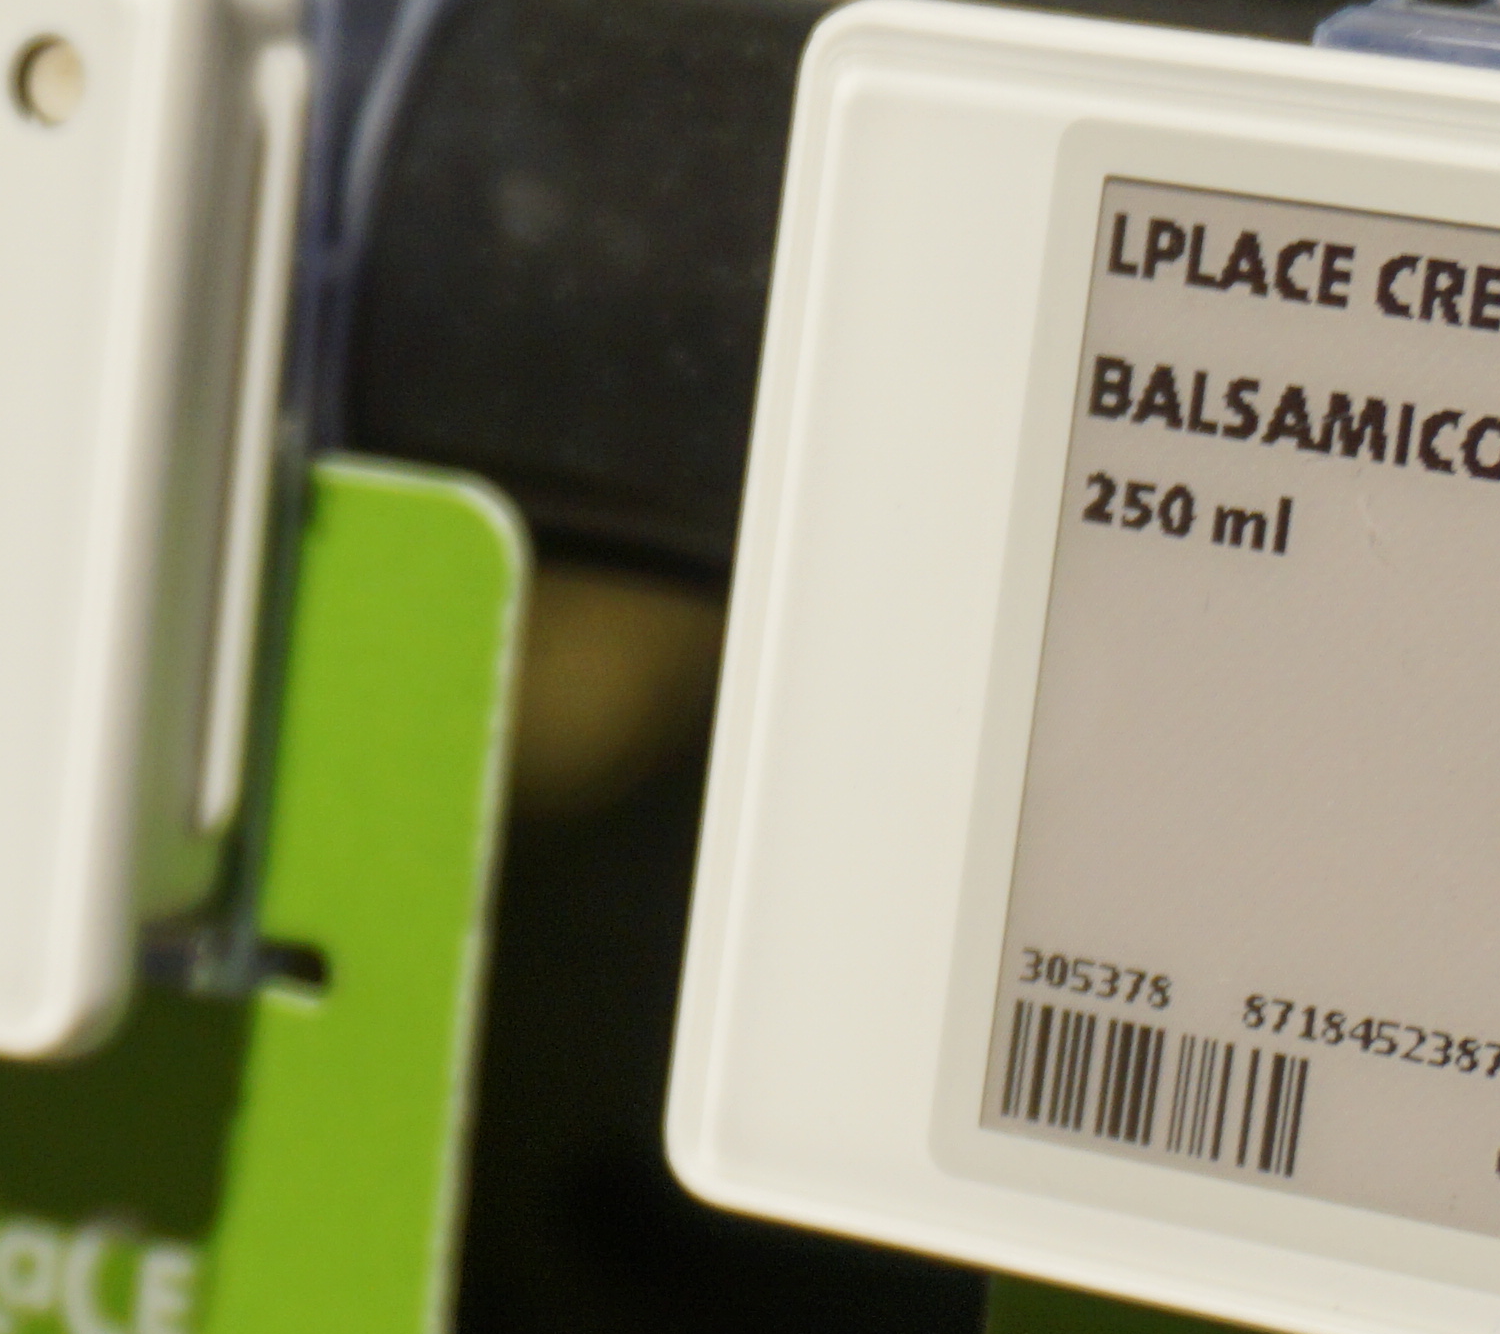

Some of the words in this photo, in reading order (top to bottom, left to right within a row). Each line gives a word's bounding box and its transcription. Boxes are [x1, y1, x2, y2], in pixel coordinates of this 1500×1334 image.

[1105, 211, 1356, 309] LPLACE
[1081, 472, 1196, 538] 250
[1211, 497, 1294, 556] ml
[1019, 946, 1171, 1009] 305378
